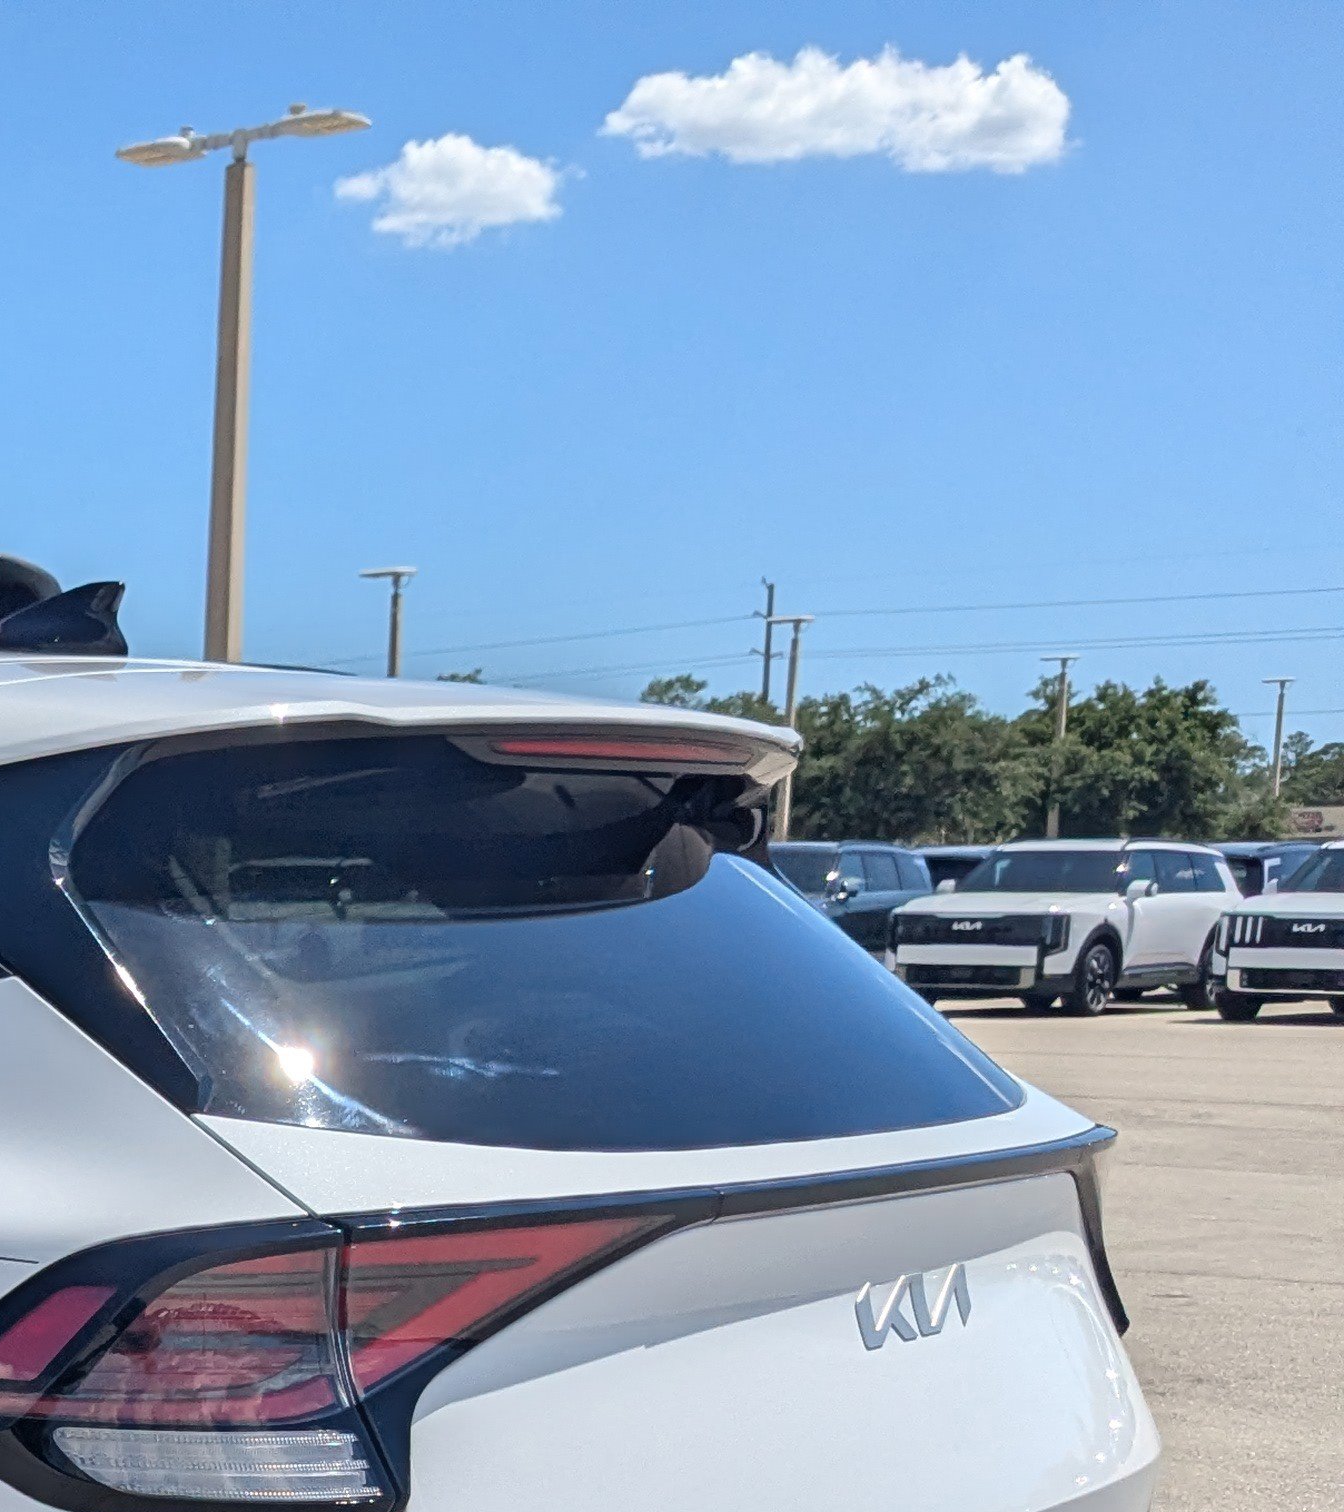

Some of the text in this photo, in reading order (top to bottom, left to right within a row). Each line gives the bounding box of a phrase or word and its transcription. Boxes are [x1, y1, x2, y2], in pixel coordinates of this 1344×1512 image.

[951, 920, 983, 932] KIA
[1291, 922, 1326, 934] KIA
[854, 1262, 972, 1351] KIA
